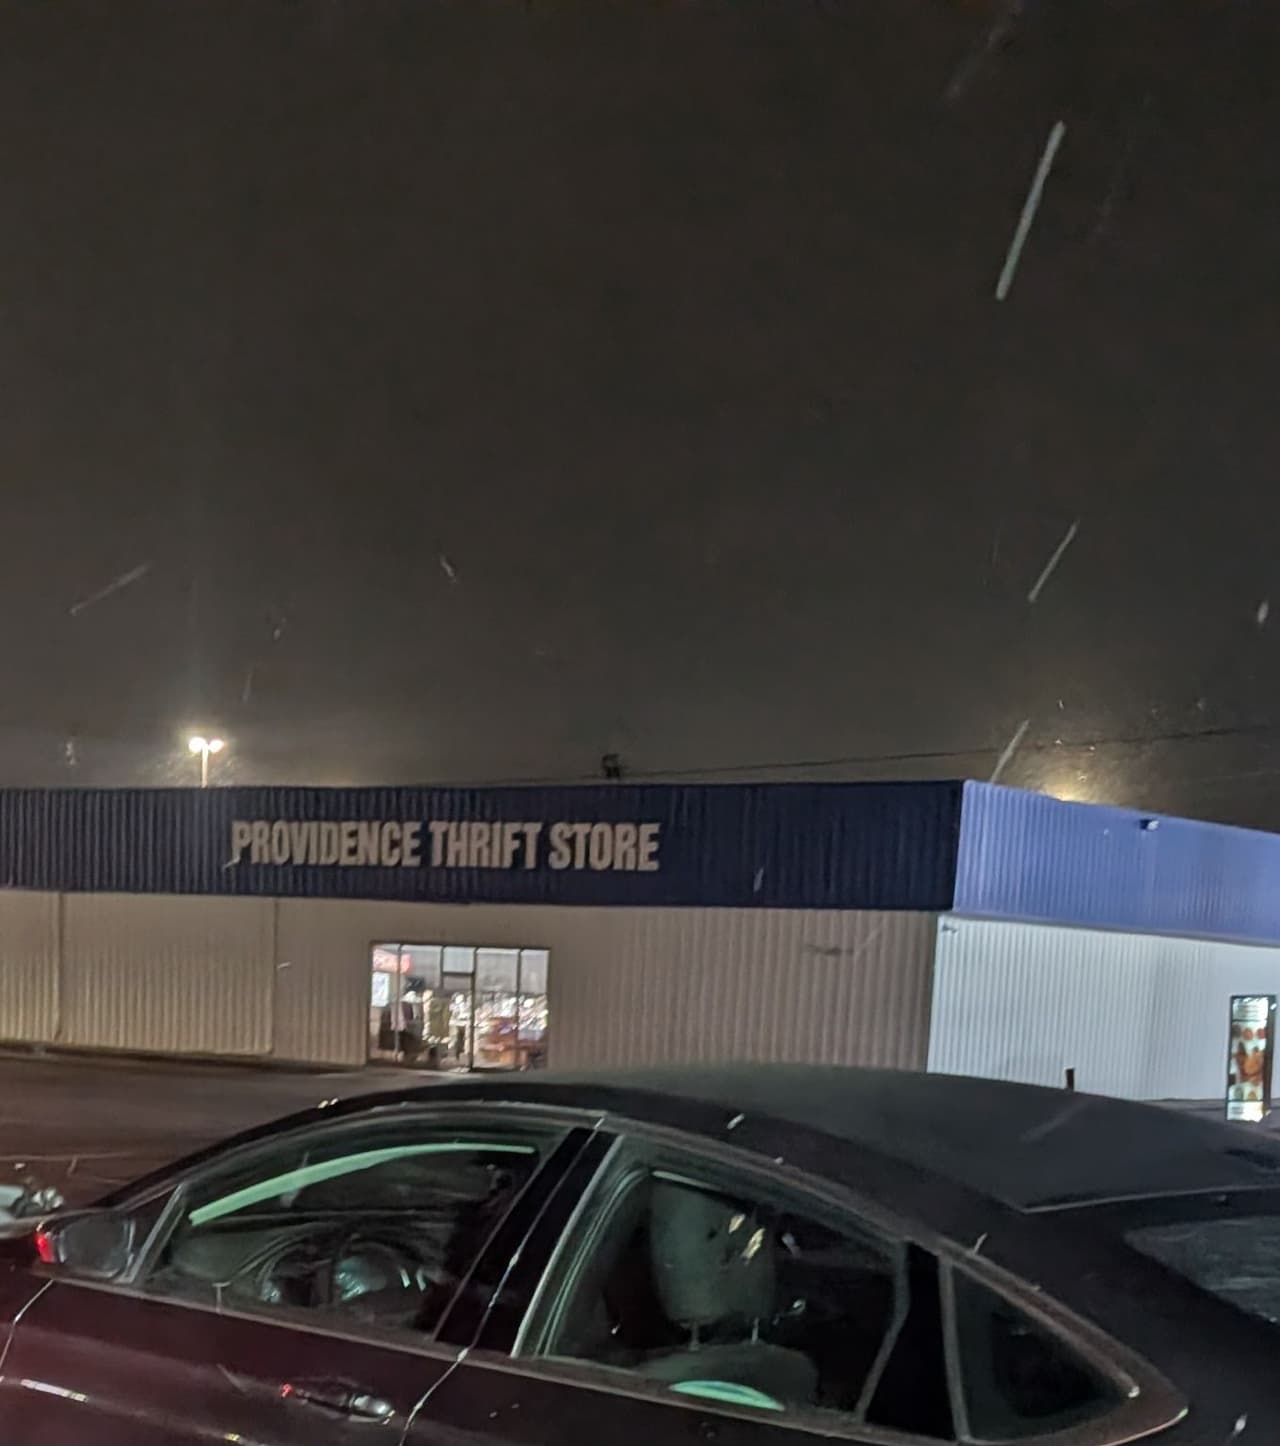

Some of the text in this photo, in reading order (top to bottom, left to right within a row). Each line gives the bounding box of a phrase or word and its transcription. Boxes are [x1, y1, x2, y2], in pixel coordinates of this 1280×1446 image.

[231, 820, 660, 871] PROVIDENCE THRIFT STORE
